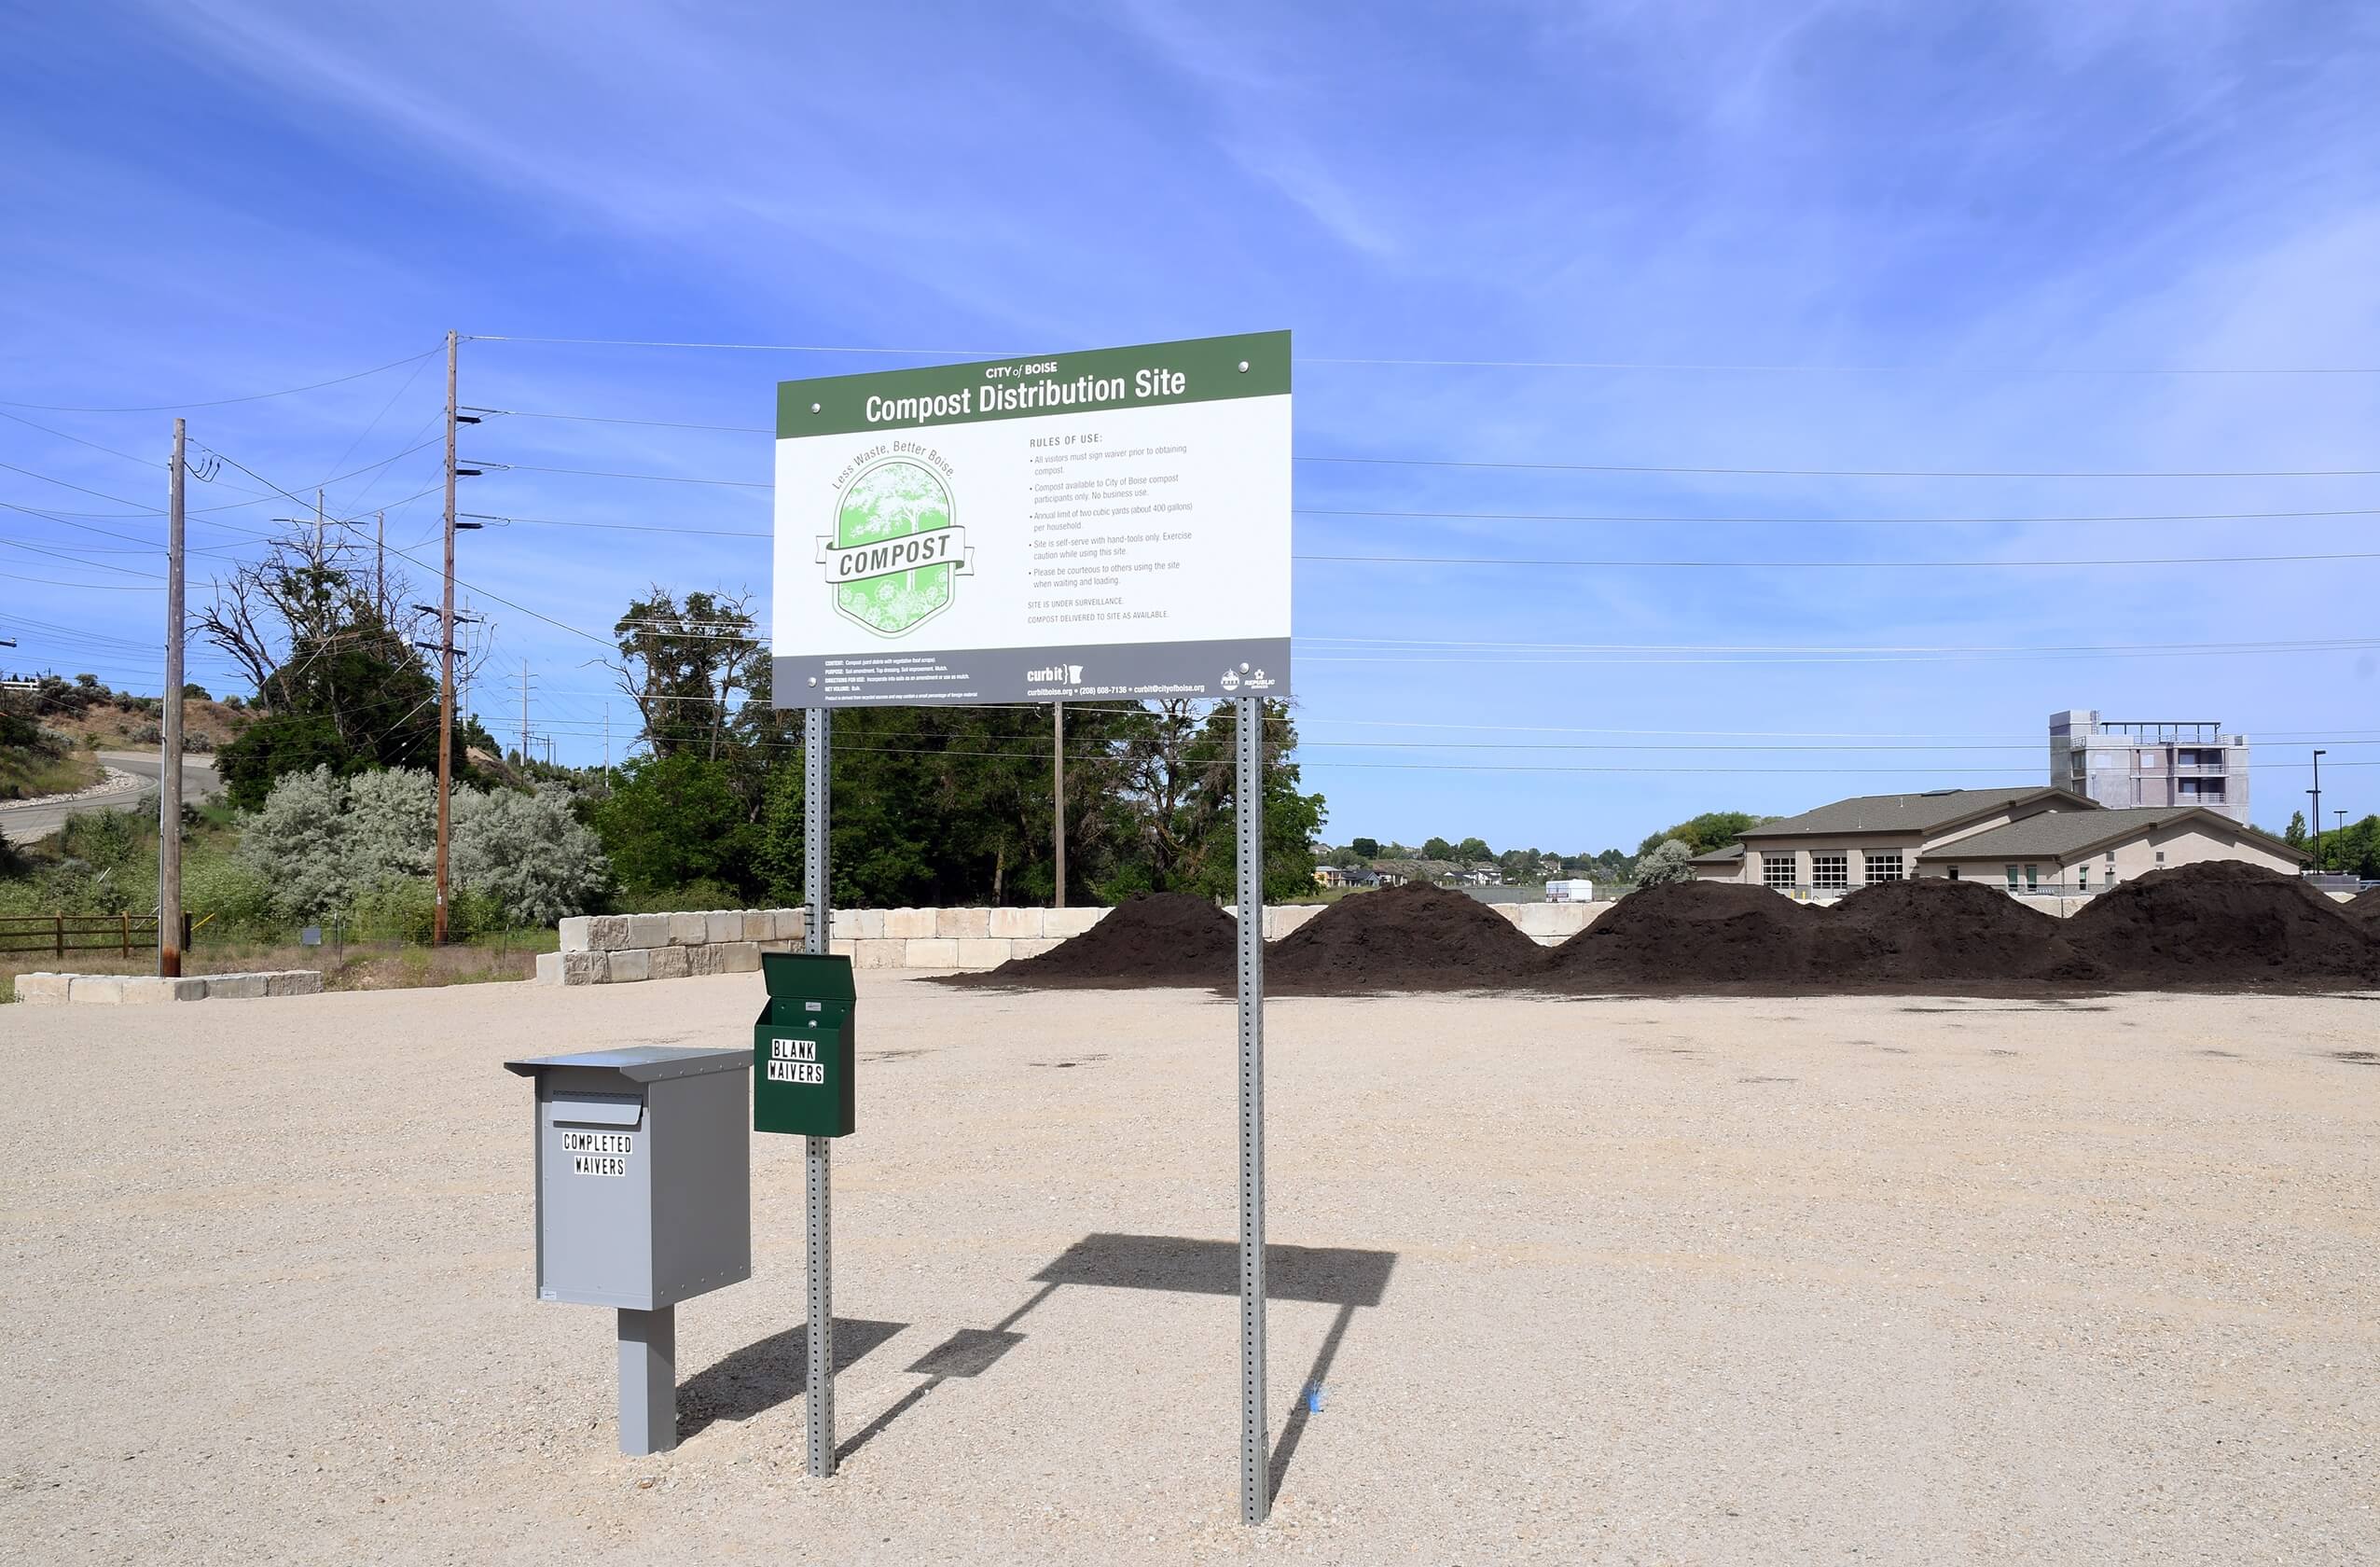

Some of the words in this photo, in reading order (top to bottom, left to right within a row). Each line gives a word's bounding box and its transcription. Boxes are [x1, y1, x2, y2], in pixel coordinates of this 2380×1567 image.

[986, 367, 1012, 379] CITY
[1013, 365, 1023, 378] of
[1025, 362, 1058, 374] BOISE
[866, 387, 971, 423] Compost
[979, 374, 1125, 412] Distribution
[1135, 367, 1185, 396] Site
[1031, 437, 1060, 448] RULES
[1065, 436, 1076, 445] OF
[1081, 434, 1103, 443] USE:
[1045, 454, 1068, 463] visitors
[1071, 452, 1086, 461] must
[1089, 451, 1102, 461] sign
[1105, 450, 1127, 458] waiver
[1128, 448, 1144, 458] prior
[1155, 445, 1186, 454] obtaining
[832, 466, 853, 490] Less
[853, 443, 890, 466] Waste,
[893, 441, 926, 455] Better
[1035, 483, 1064, 492] Compost
[1065, 480, 1095, 490] available
[1105, 478, 1118, 488] City
[1128, 477, 1147, 485] Boise
[1149, 475, 1179, 484] compost
[1034, 494, 1072, 505] participants
[1103, 490, 1132, 499] business
[1034, 511, 1056, 520] Annual
[1112, 507, 1129, 517] yards
[1034, 524, 1045, 533] per
[1033, 540, 1046, 548] Site
[1056, 538, 1088, 547] self-serve
[1091, 536, 1105, 545] with
[1163, 532, 1192, 540] Exercise
[839, 534, 950, 575] COMPOST
[1034, 551, 1058, 561] caution
[1060, 550, 1077, 559] while
[1079, 549, 1098, 559] using
[1033, 568, 1056, 576] Please
[1058, 567, 1065, 575] be
[1067, 565, 1100, 575] courteous
[1111, 563, 1132, 573] others
[1134, 562, 1153, 572] using
[1155, 562, 1165, 570] the
[1054, 578, 1077, 588] waiting
[1079, 577, 1092, 586] and
[1028, 616, 1058, 624] COMPOST
[1060, 614, 1095, 622] DELIVERED
[773, 1039, 815, 1060] BLANK
[769, 1062, 823, 1083] WAIVERS
[564, 1133, 631, 1153] COMPLETED
[575, 1158, 624, 1175] WAIVERS
